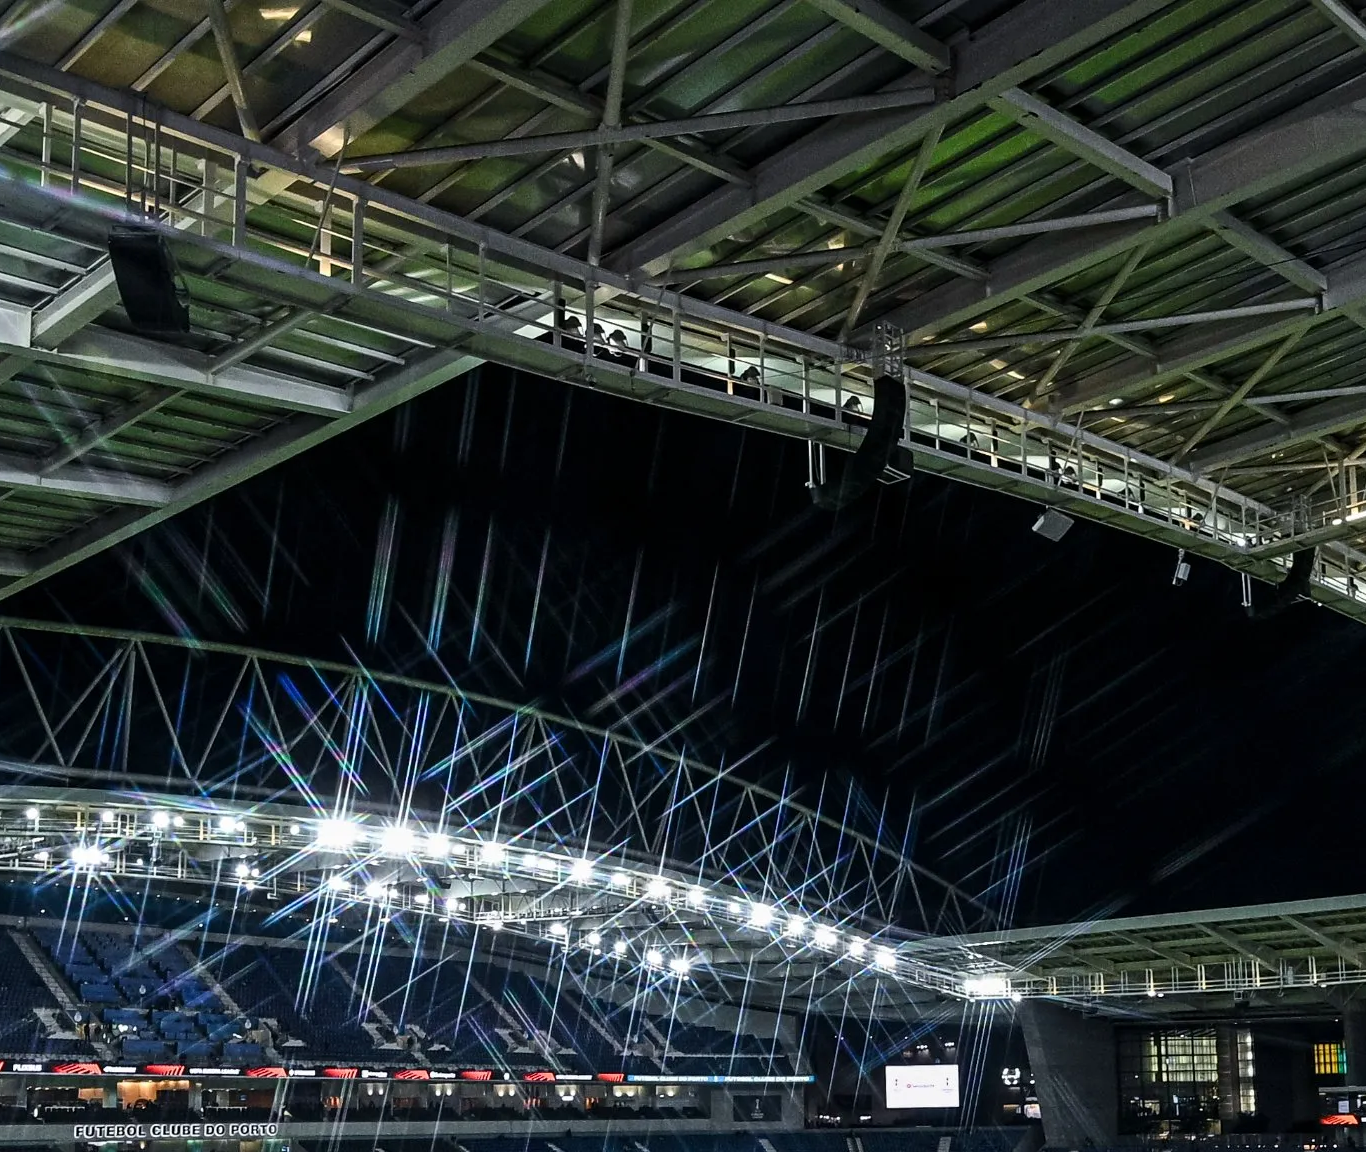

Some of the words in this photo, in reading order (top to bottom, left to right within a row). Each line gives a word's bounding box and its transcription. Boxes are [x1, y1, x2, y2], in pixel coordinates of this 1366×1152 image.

[74, 1124, 145, 1139] FUTEBOL
[150, 1123, 200, 1138] CLUBE
[203, 1123, 226, 1137] DO
[229, 1122, 279, 1136] PORTO
